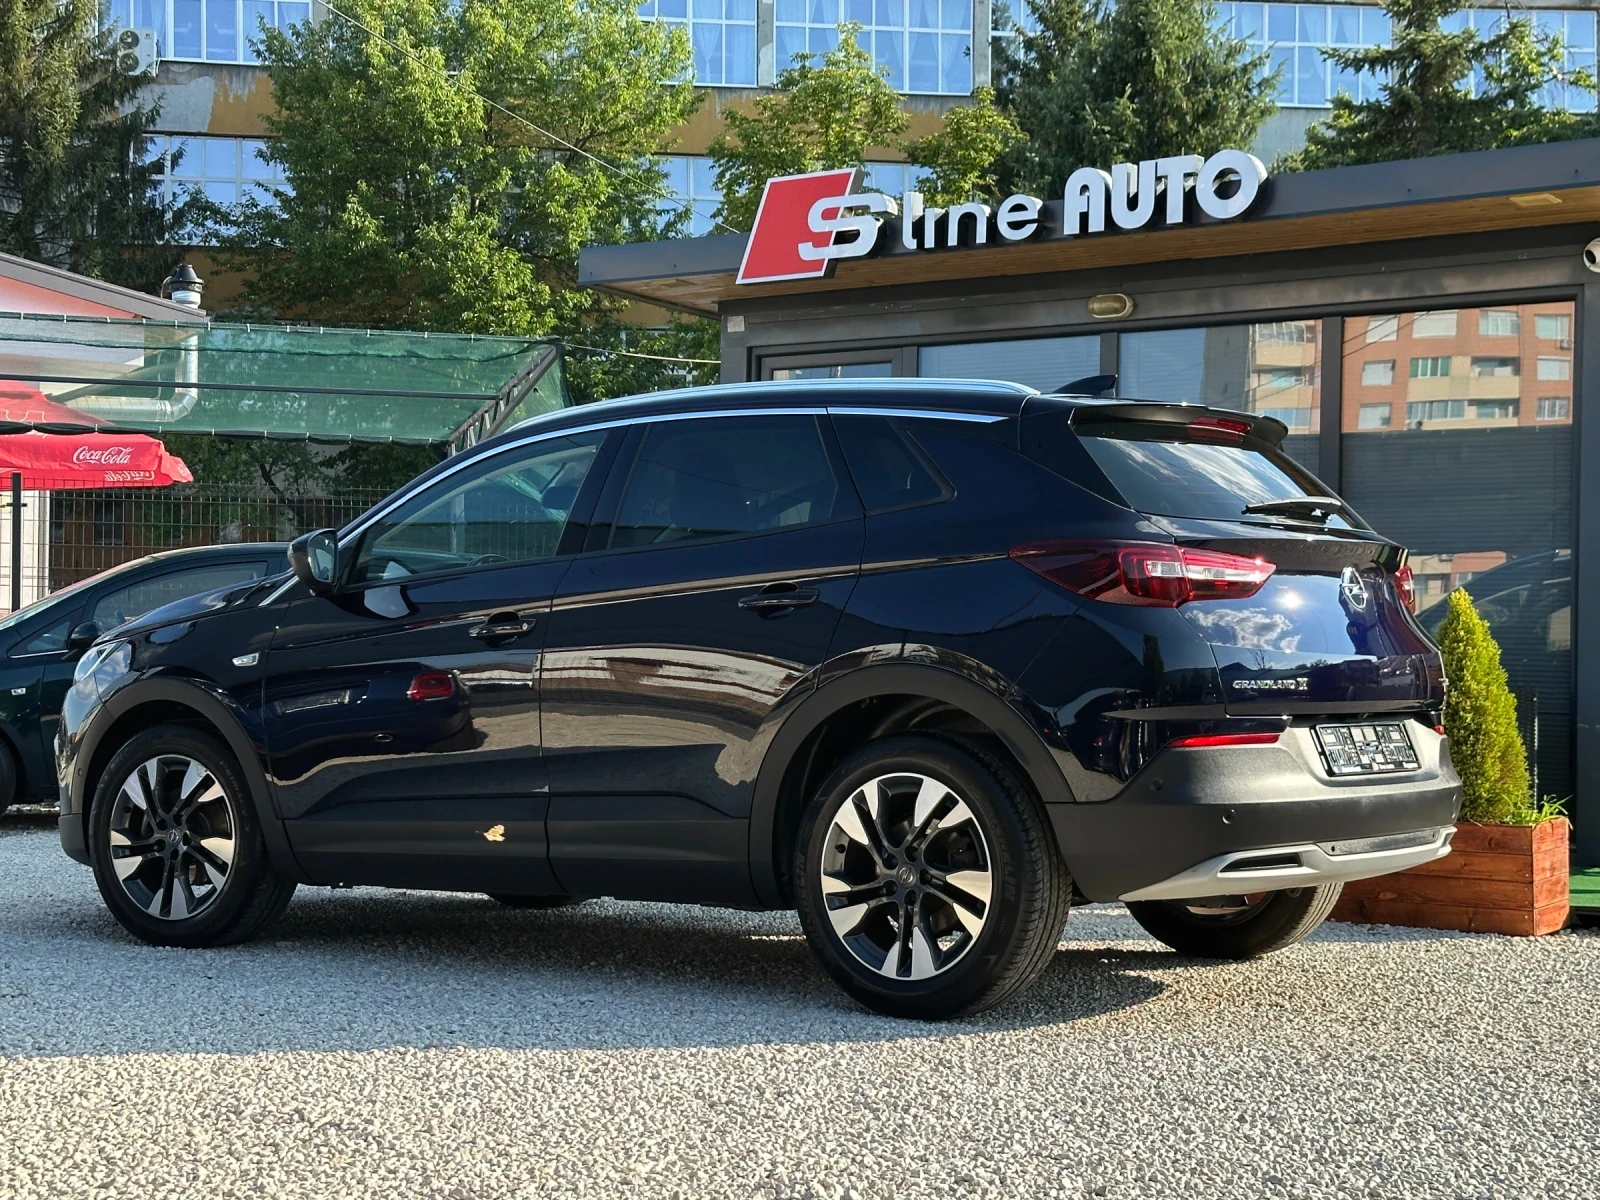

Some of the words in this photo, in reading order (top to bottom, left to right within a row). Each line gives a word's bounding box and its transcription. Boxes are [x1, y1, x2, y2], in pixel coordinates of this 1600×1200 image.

[797, 194, 898, 262] S
[902, 191, 1042, 251] line
[1063, 149, 1266, 236] AUTO
[72, 445, 134, 464] Coca-Cola
[1296, 677, 1308, 691] X
